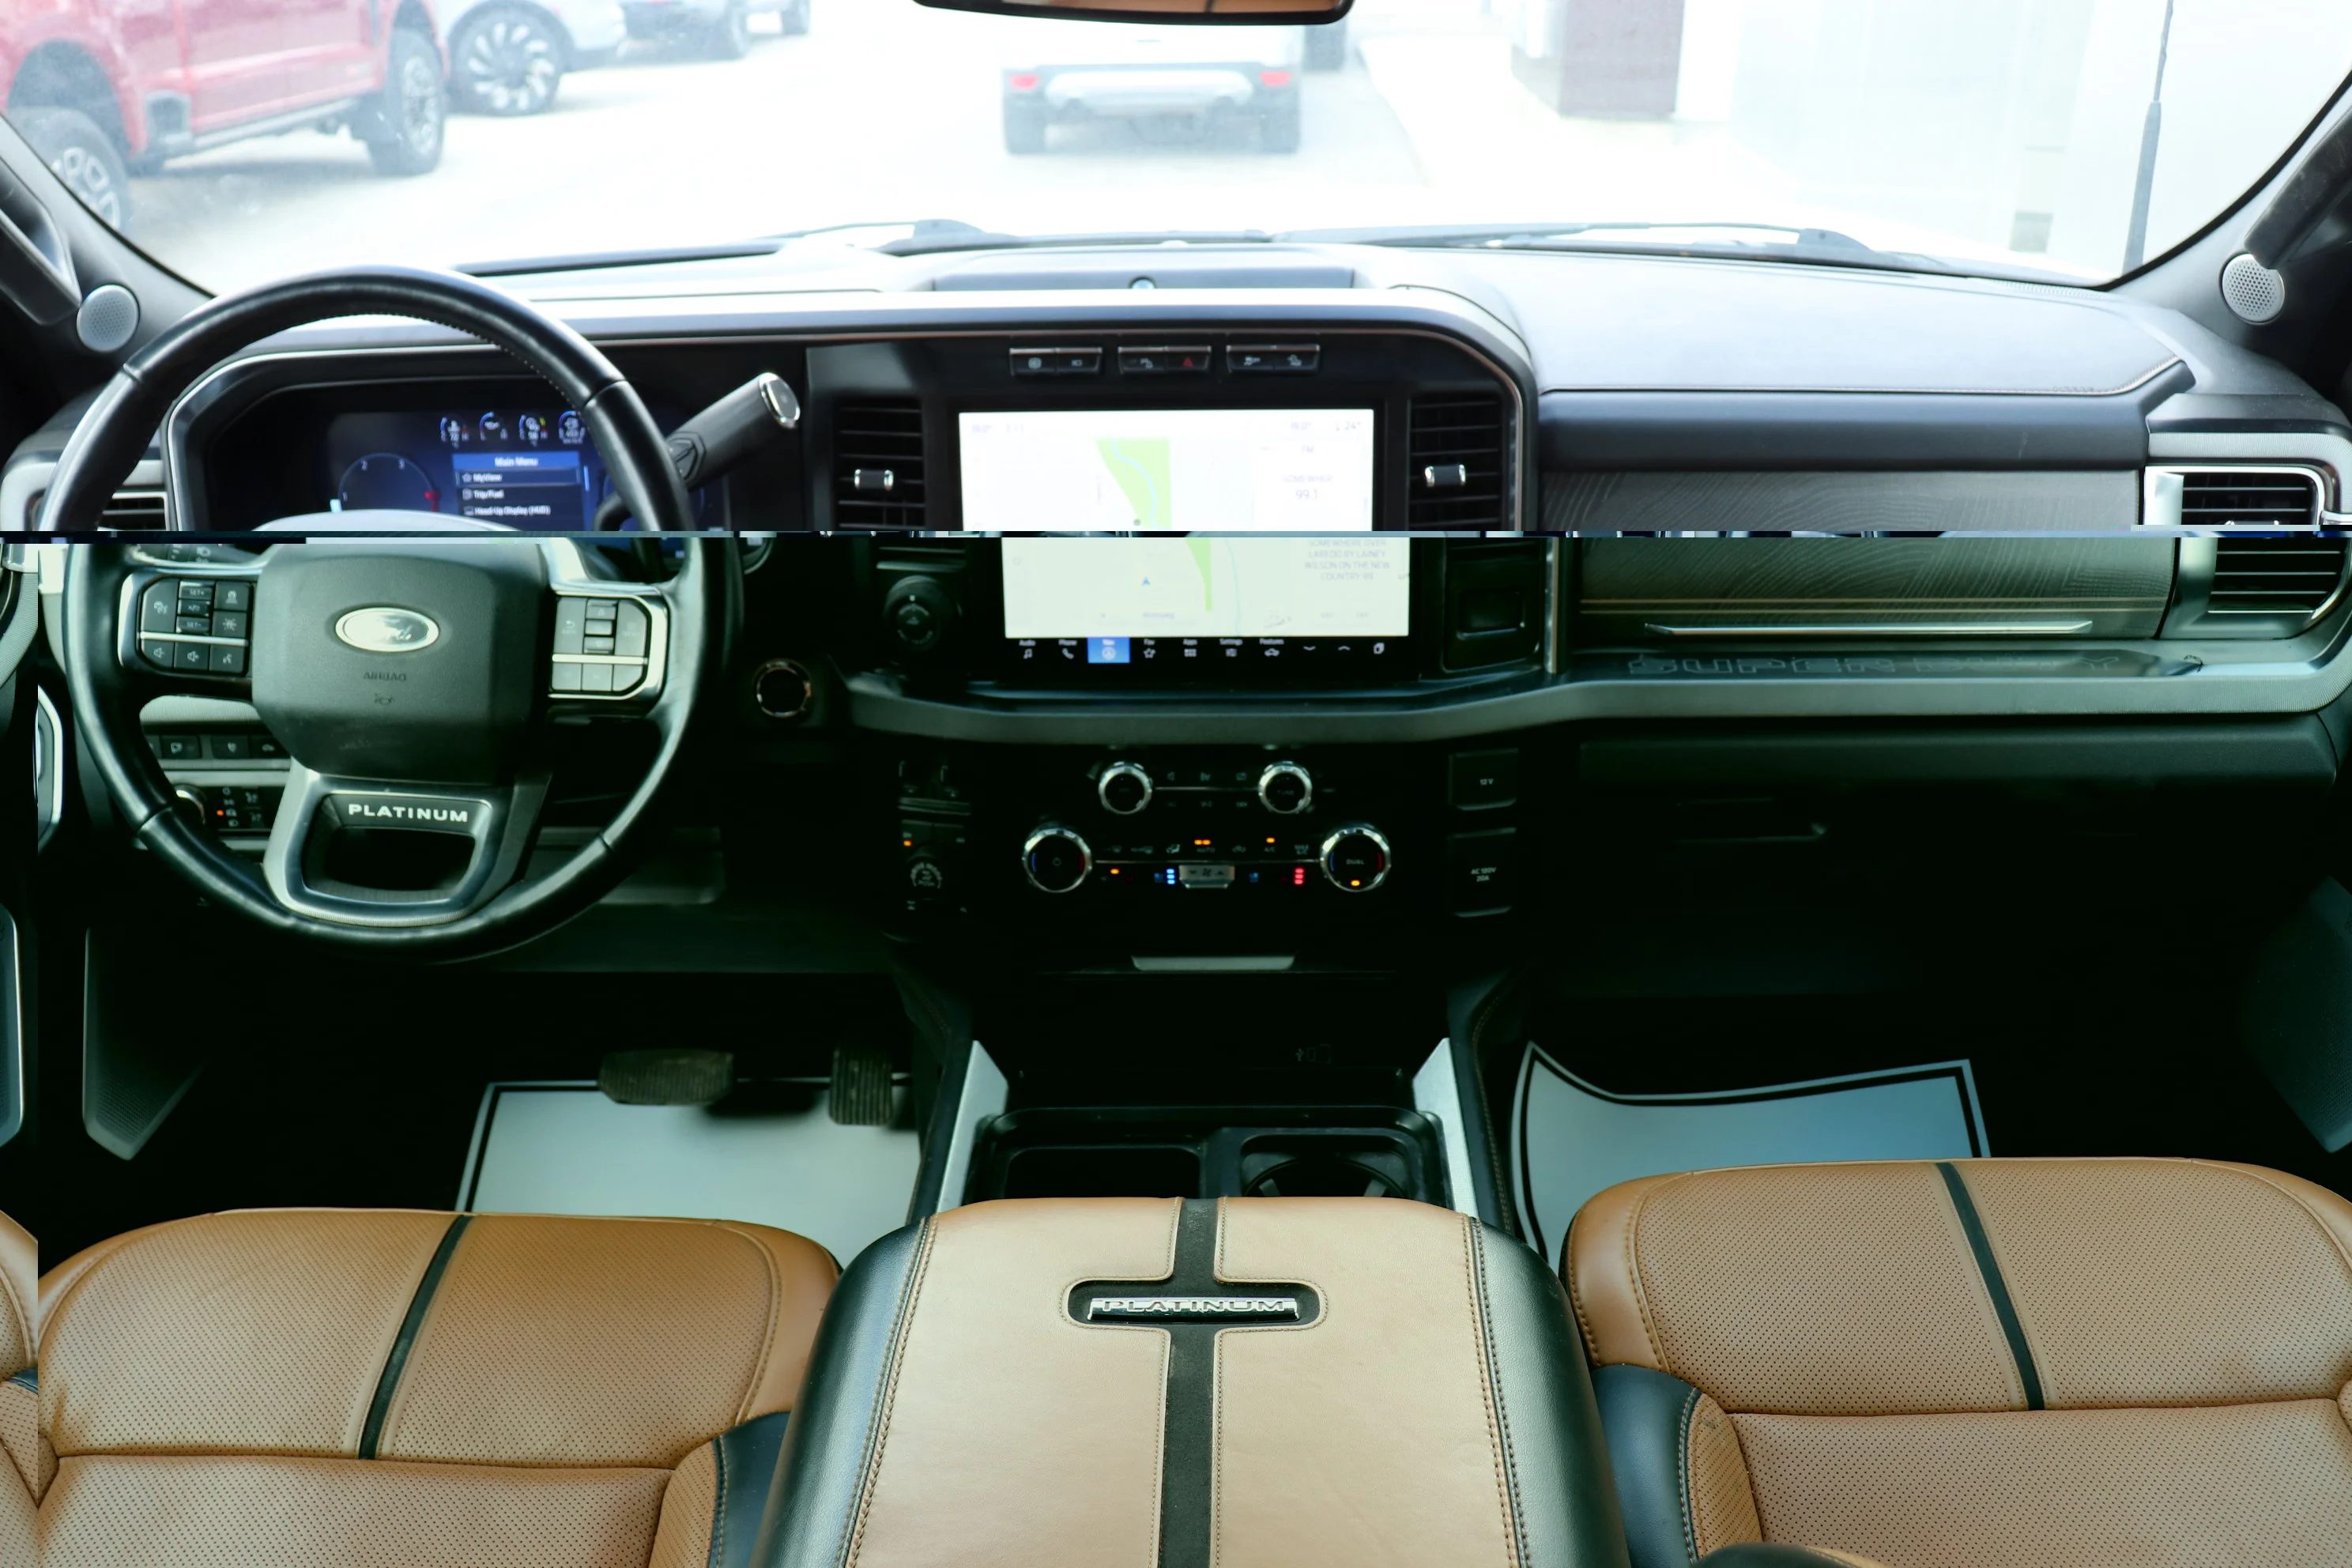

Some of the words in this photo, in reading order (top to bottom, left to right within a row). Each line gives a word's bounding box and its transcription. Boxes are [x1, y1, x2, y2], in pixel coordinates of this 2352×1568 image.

[495, 458, 513, 467] Main
[515, 456, 539, 467] Menu
[473, 473, 503, 483] MyView
[1295, 488, 1317, 500] 99.1
[348, 803, 468, 823] PLATINUM
[1346, 858, 1365, 866] DUAL
[1103, 1300, 1285, 1312] PLATINUM
